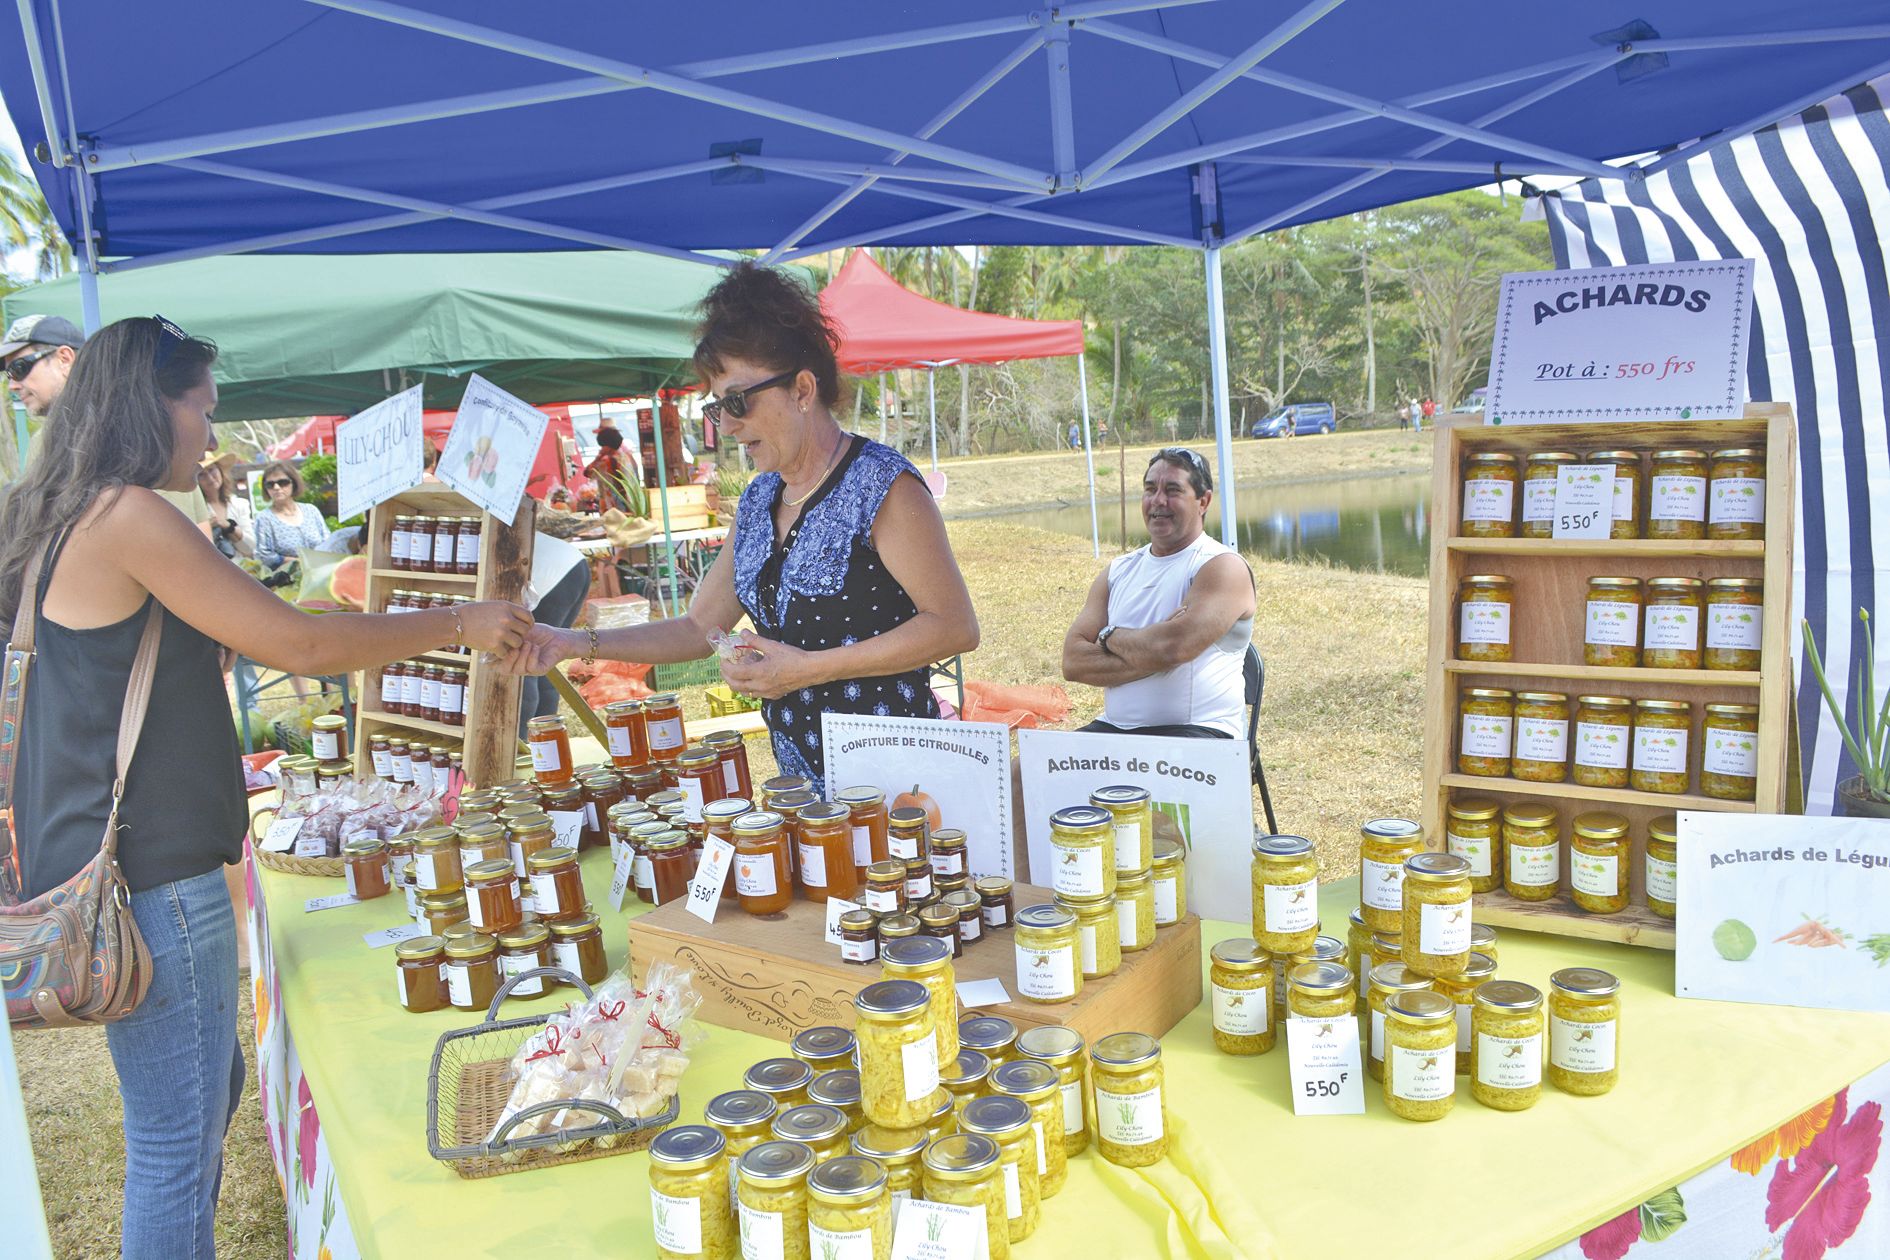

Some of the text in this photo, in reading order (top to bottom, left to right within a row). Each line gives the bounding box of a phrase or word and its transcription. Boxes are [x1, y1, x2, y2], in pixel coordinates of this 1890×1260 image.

[1532, 283, 1711, 326] ACHARDS
[1535, 362, 1573, 379] Pot
[1582, 360, 1598, 379] à
[1614, 362, 1655, 380] 550
[1656, 355, 1696, 381] frs
[343, 404, 415, 466] LILY-CHOU
[841, 736, 990, 766] CONFITURE DE CITROUILLES
[1048, 755, 1217, 786] Achards de Cocos
[1709, 846, 1890, 869] Achards de Légu
